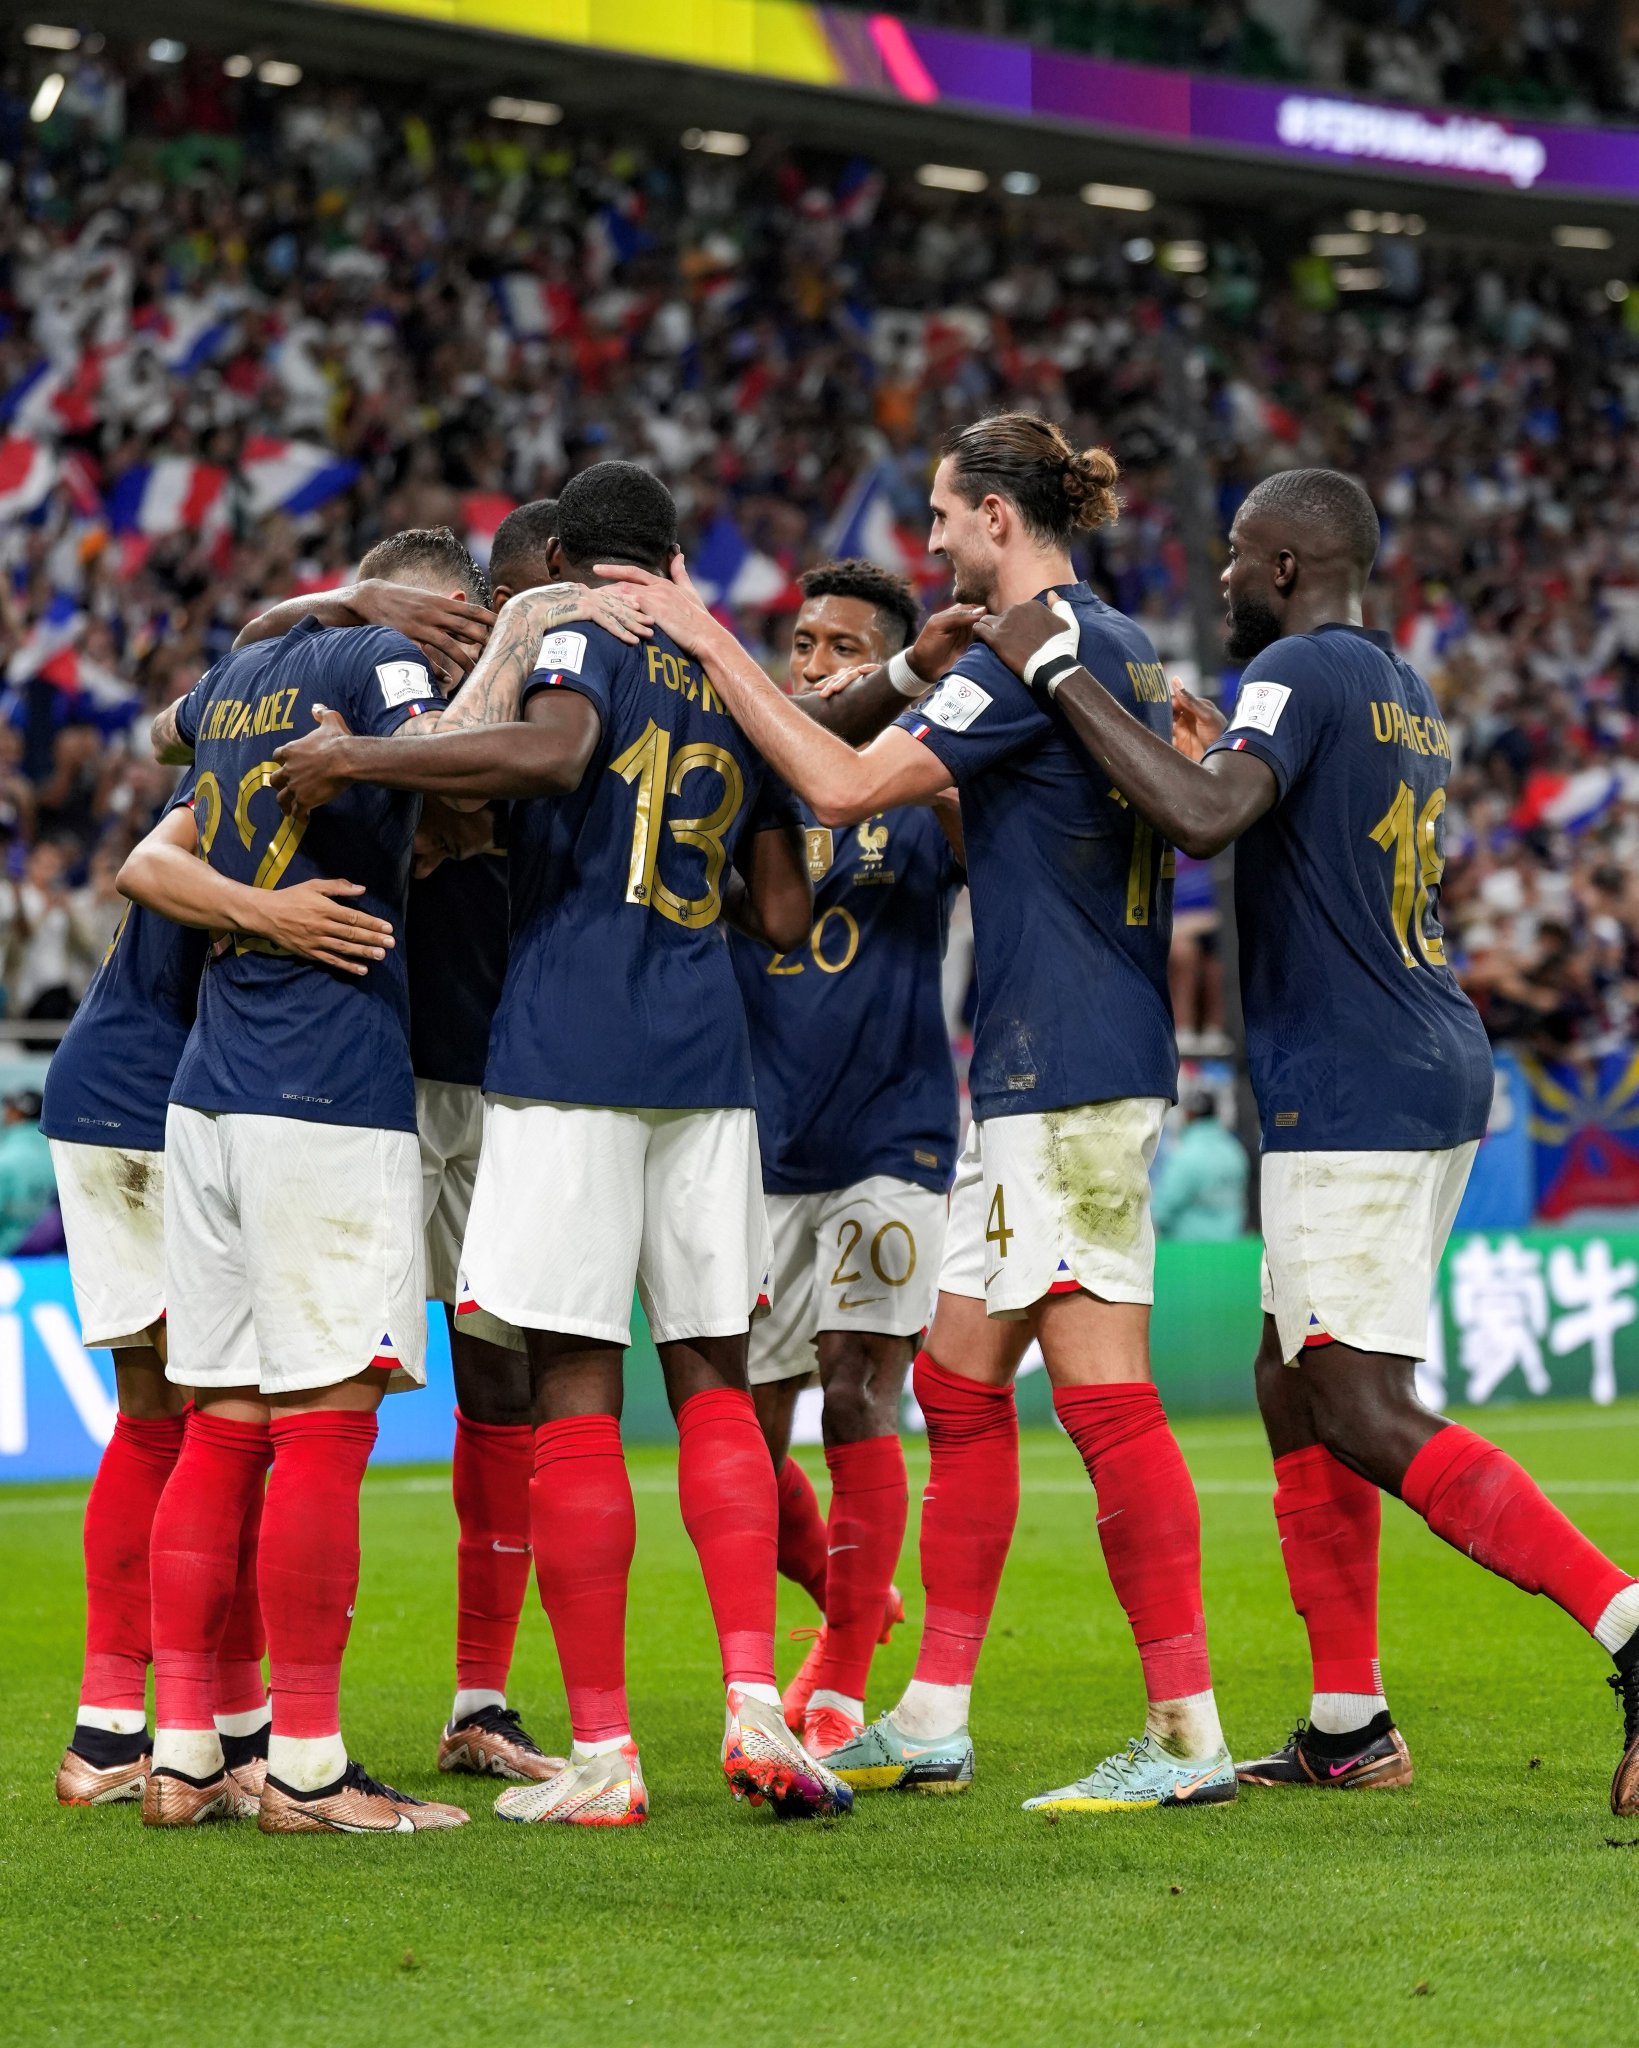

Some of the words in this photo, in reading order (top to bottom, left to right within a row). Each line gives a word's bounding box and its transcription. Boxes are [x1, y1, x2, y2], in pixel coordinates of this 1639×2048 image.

[646, 645, 731, 716] FOFAN
[609, 716, 744, 929] 13
[1368, 779, 1447, 968] 18
[831, 1219, 917, 1287] 20
[1453, 1233, 1638, 1405] 蒙牛
[1124, 1788, 1157, 1796] PHANTOM
